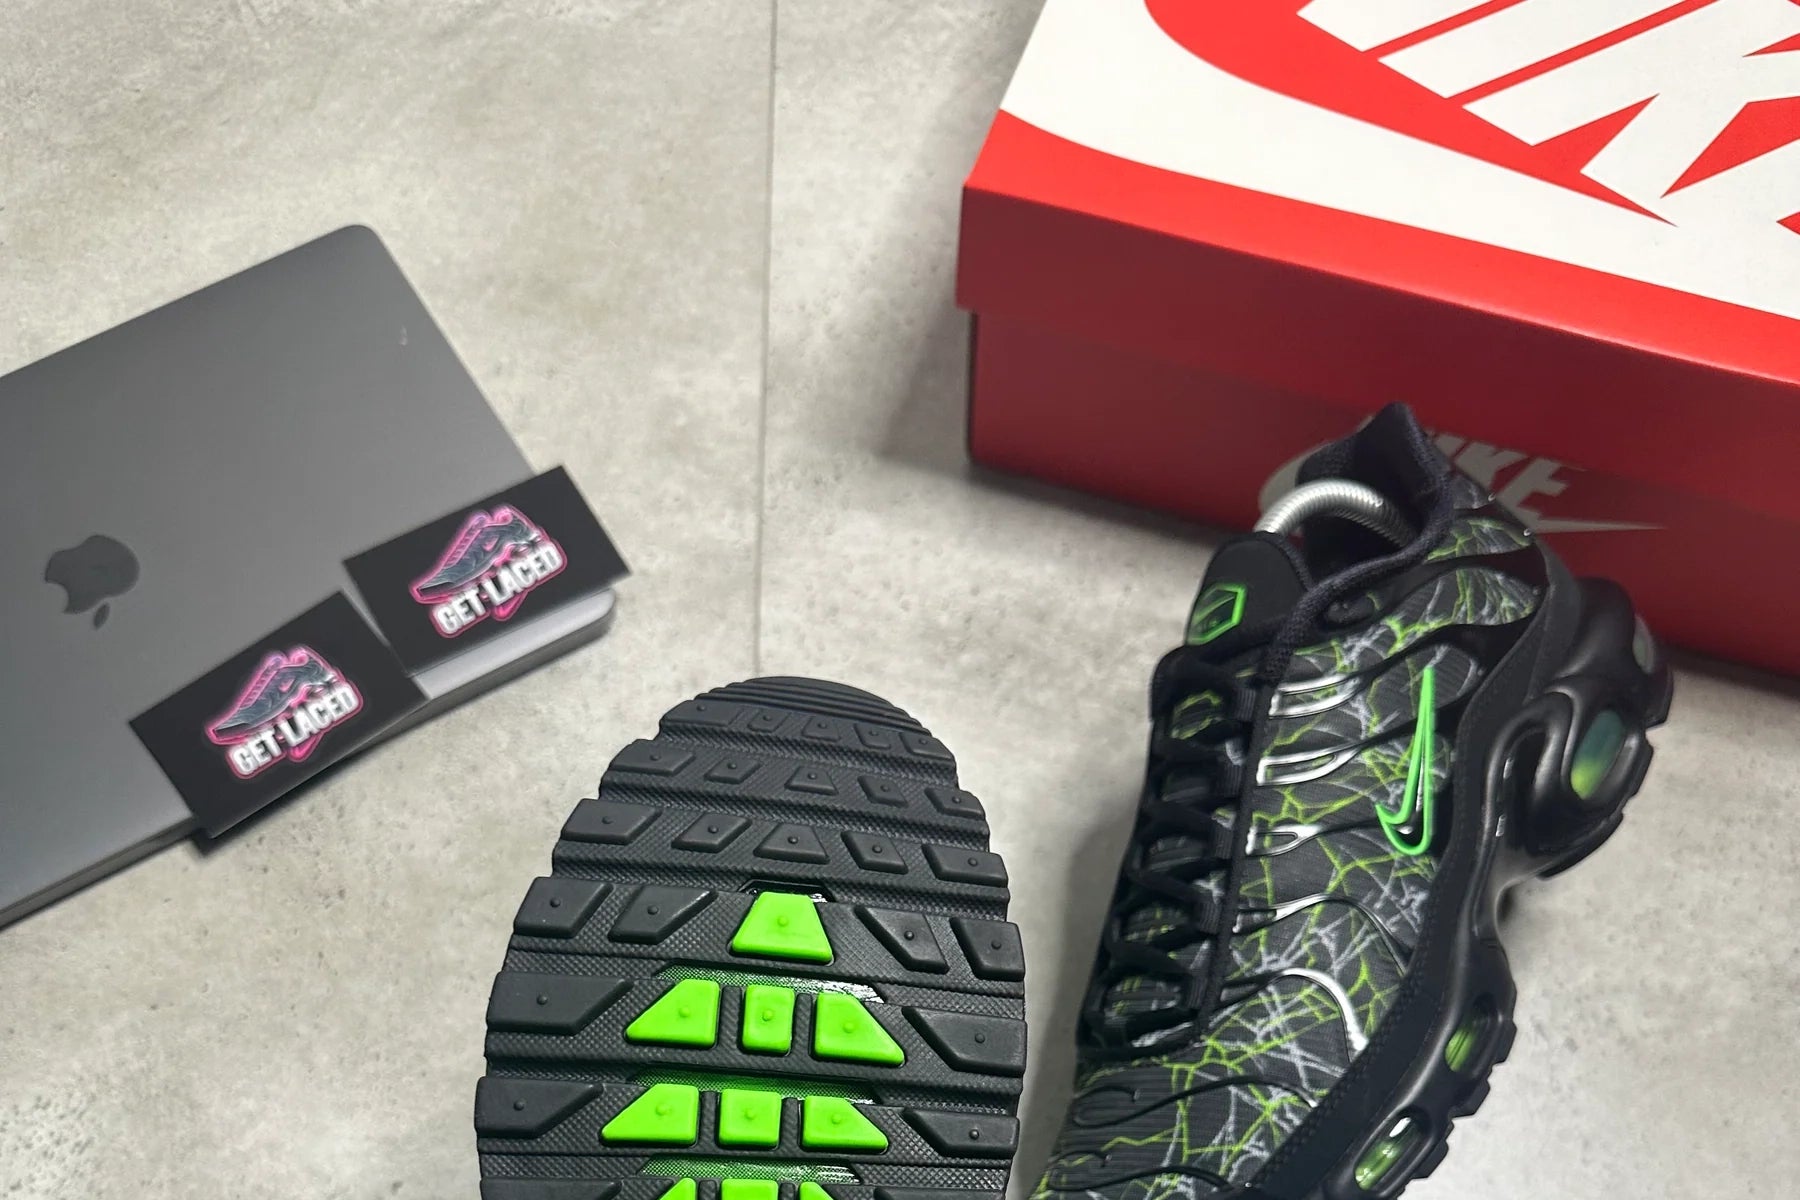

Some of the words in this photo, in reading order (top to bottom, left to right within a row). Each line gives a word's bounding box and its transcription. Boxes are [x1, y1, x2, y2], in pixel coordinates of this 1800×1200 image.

[432, 584, 486, 635] GET
[482, 542, 564, 606] LACED
[230, 726, 283, 776] GET
[279, 683, 360, 746] LACED
